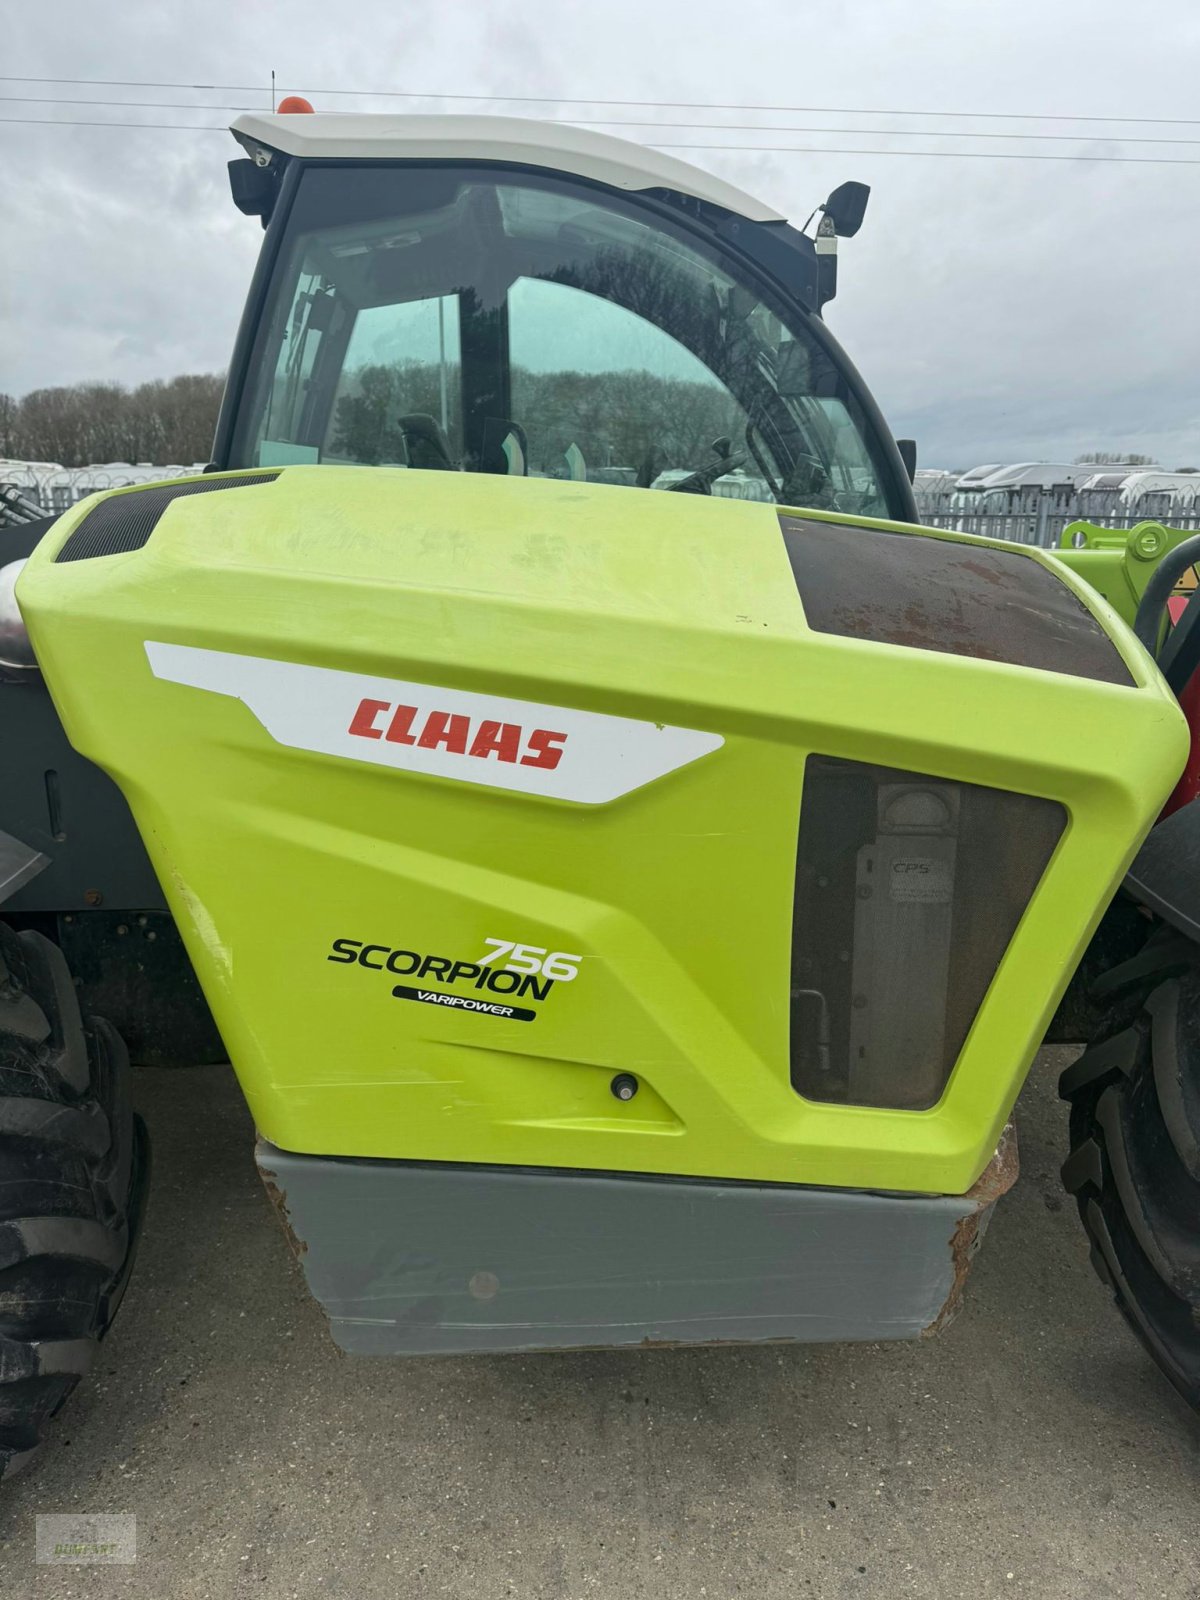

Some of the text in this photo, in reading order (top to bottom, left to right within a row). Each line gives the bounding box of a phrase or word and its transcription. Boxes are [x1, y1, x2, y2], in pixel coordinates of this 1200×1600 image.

[348, 698, 568, 770] CLAAS
[893, 863, 929, 873] CPS
[327, 938, 555, 1001] SCORPION
[475, 937, 583, 982] 756
[416, 990, 514, 1017] VARIPOWER
